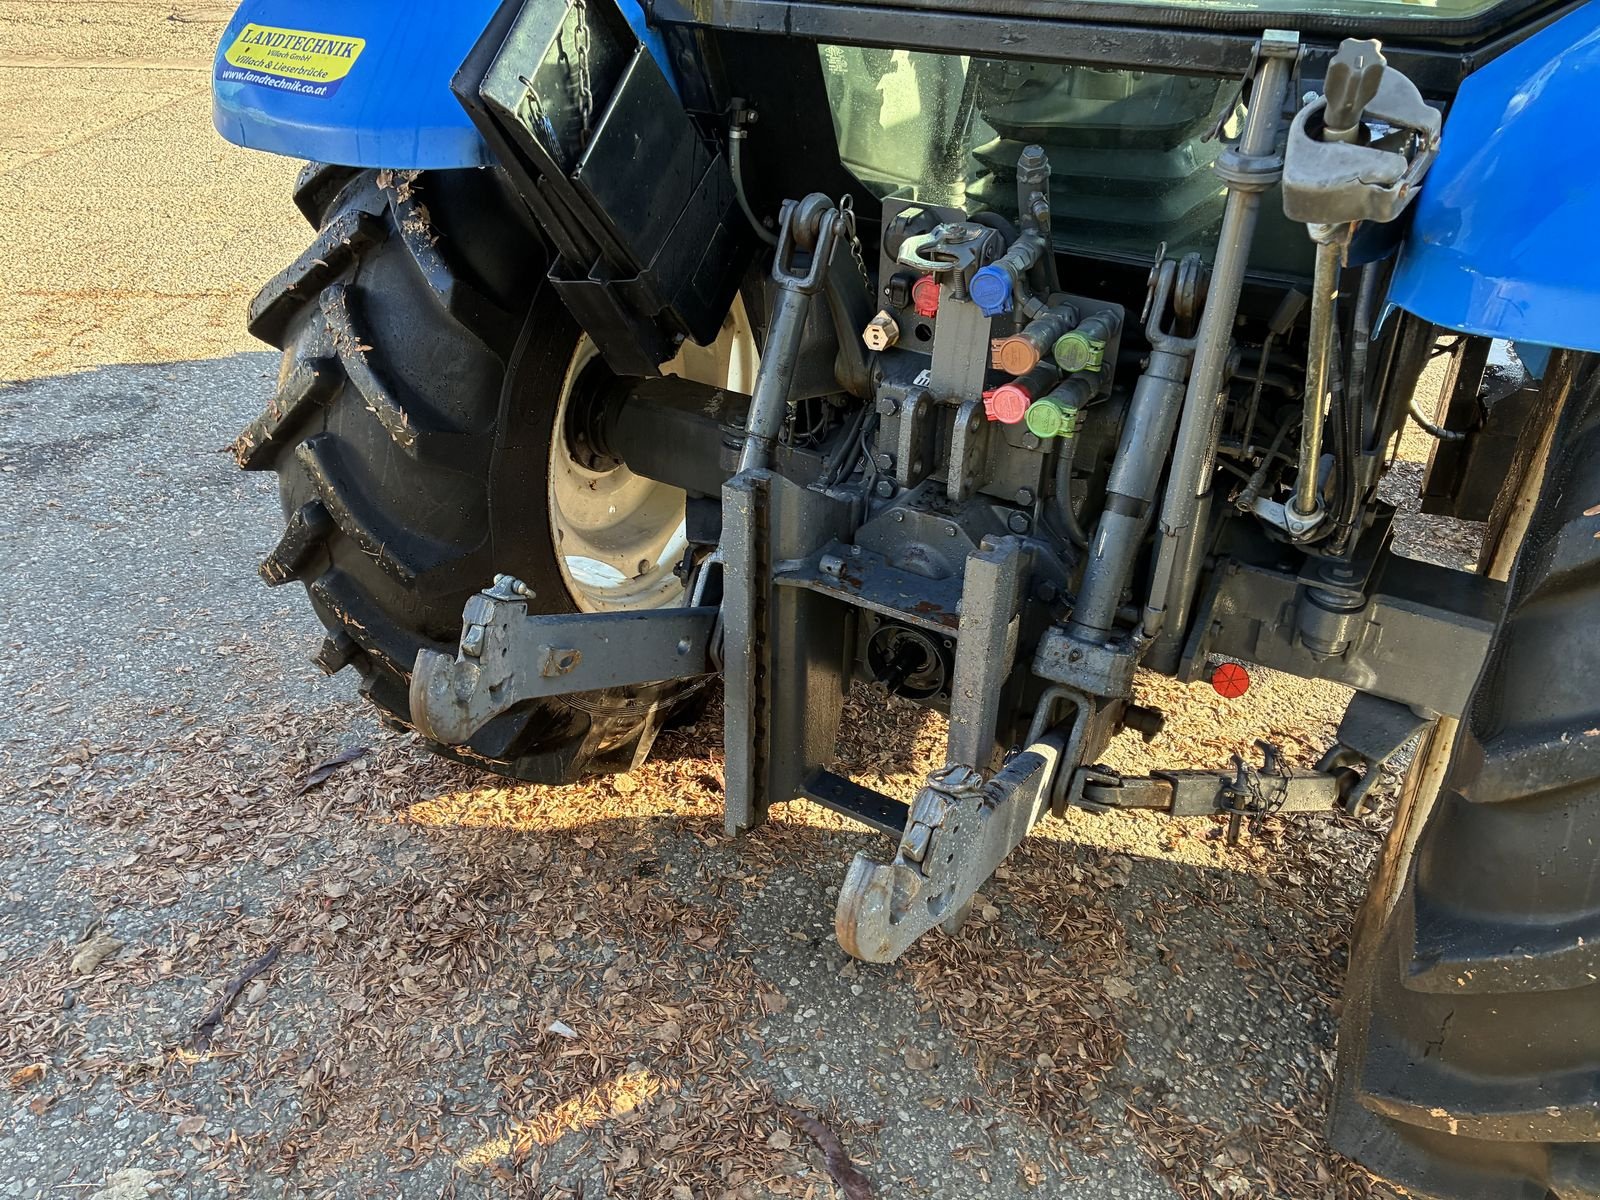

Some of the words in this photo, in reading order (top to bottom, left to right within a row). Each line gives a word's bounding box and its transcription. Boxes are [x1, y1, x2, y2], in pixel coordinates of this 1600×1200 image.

[240, 29, 358, 58] LANDTECHNIK
[267, 49, 289, 59] Villach
[290, 53, 312, 62] GmbH
[235, 55, 264, 68] Villach
[265, 60, 272, 69] &
[273, 61, 329, 79] Lieserbrücke
[222, 70, 327, 96] www.landtechnik.co.at
